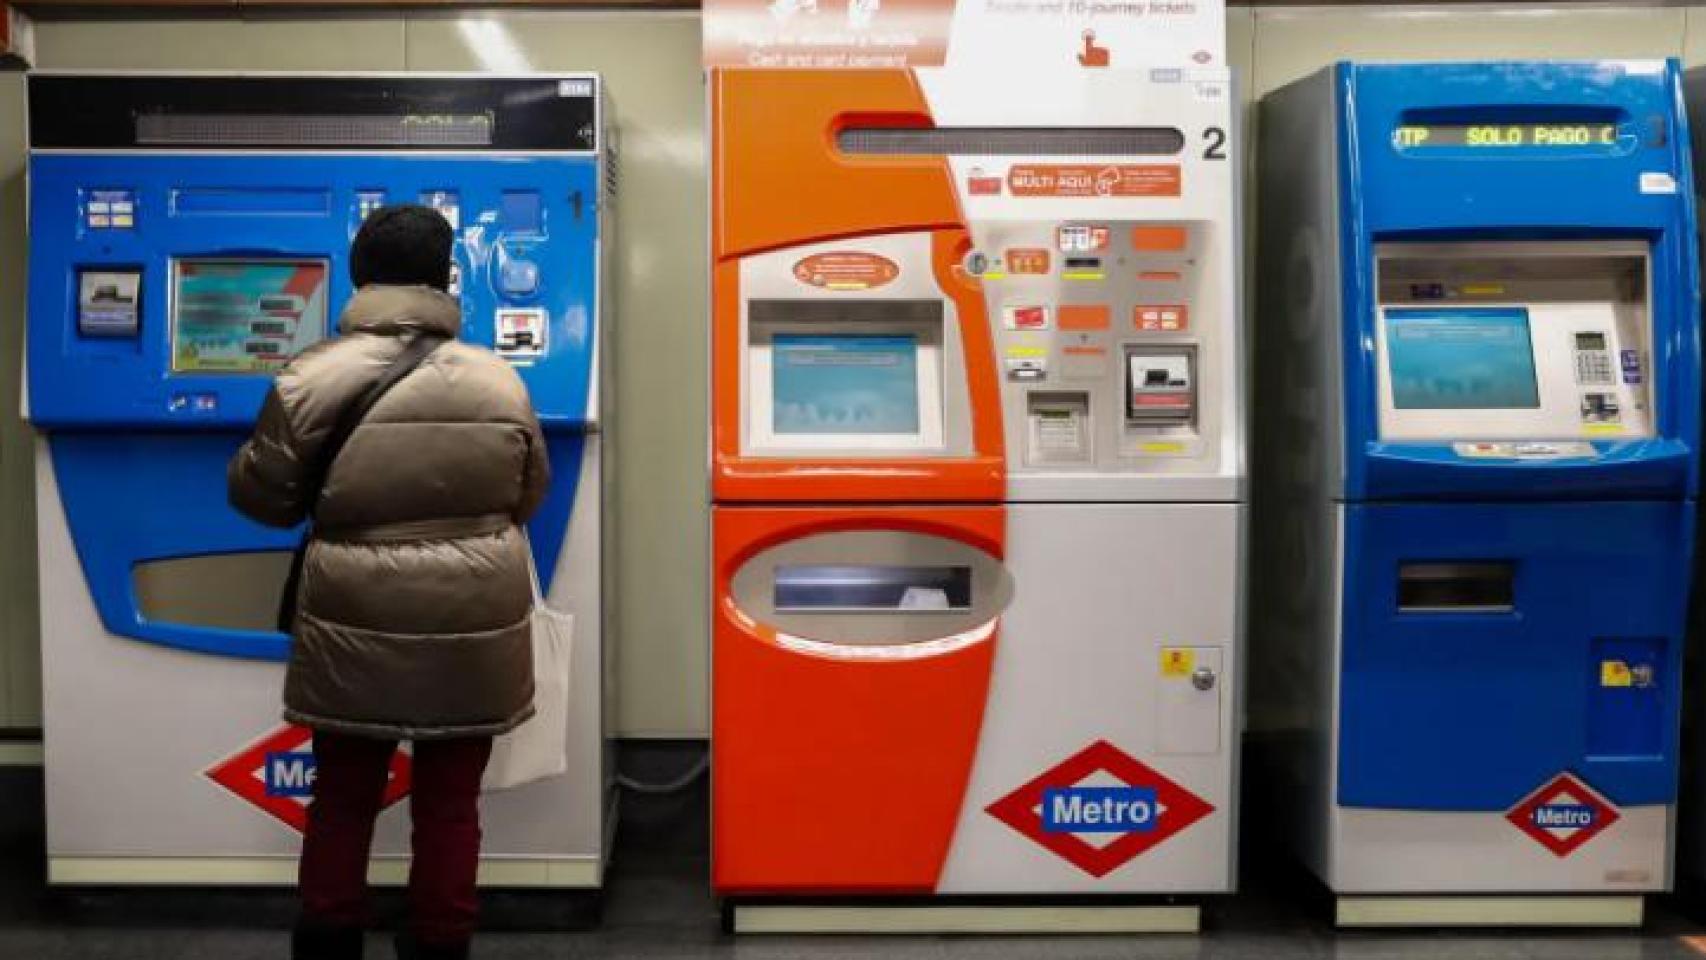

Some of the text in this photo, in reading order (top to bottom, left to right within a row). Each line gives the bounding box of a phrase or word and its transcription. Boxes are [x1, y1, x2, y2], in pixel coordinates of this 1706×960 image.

[1202, 127, 1227, 160] 2
[1465, 126, 1522, 145] SOLO
[1053, 794, 1151, 824] Metro
[1537, 807, 1591, 824] Metro
